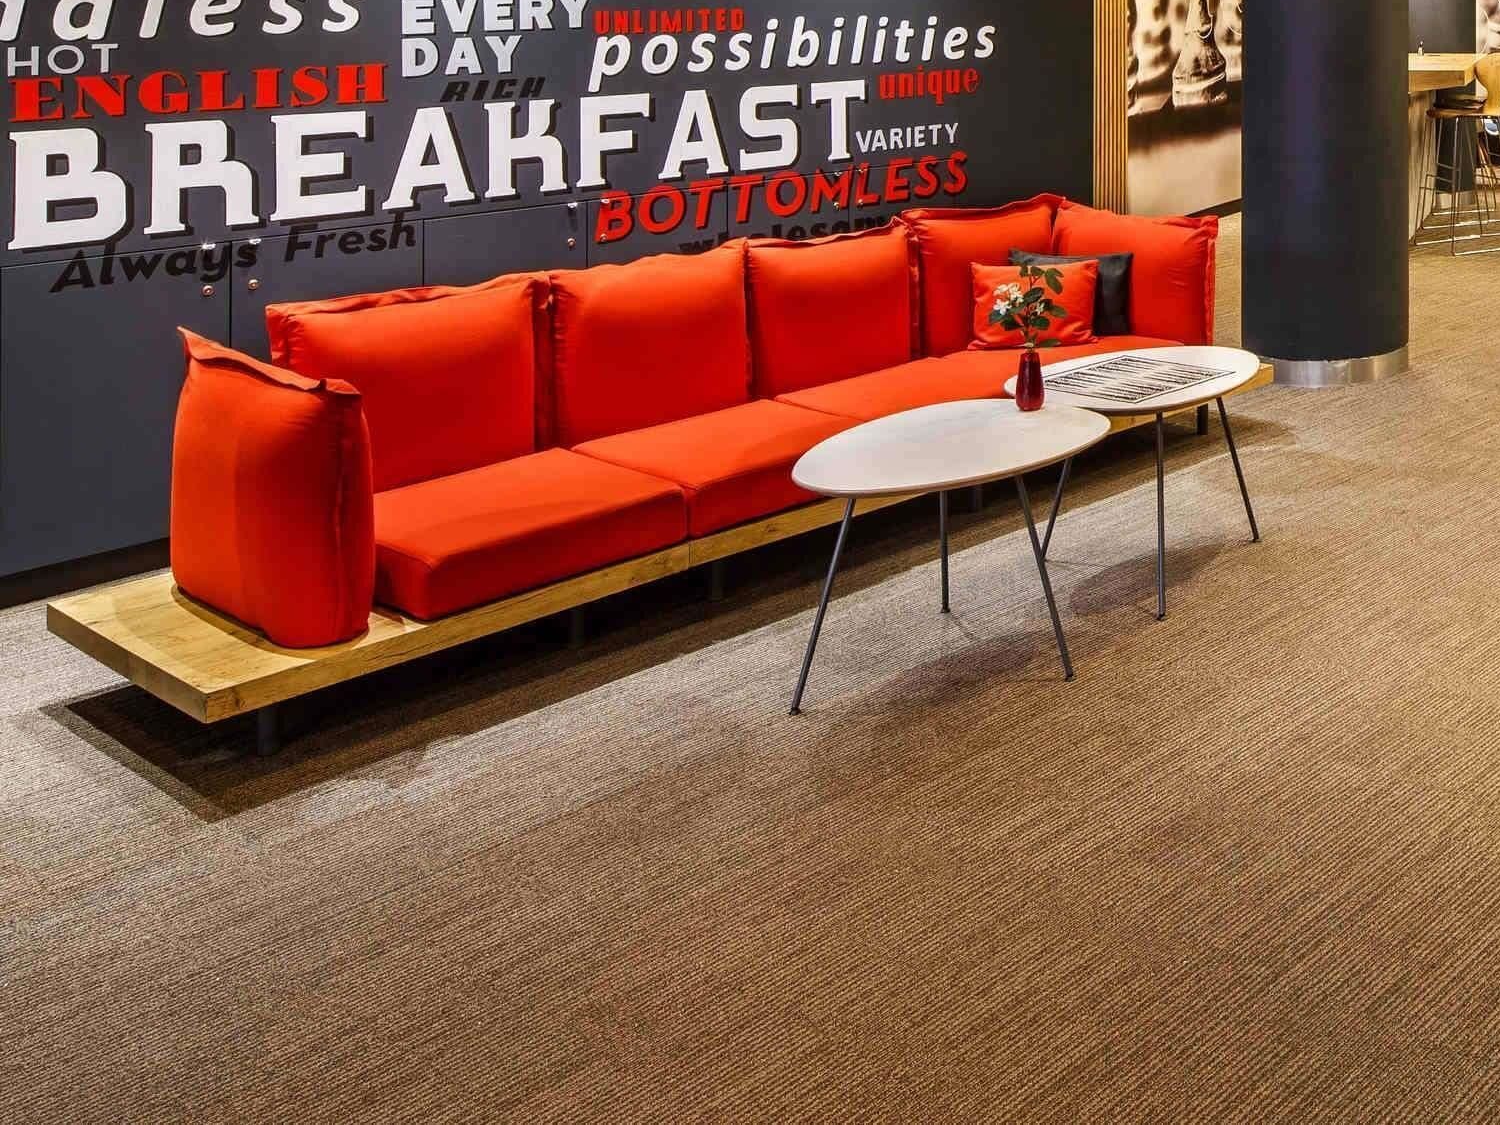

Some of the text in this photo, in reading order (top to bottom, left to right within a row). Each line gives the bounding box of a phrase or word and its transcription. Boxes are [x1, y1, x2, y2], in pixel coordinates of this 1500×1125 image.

[593, 7, 746, 36] UNLIMITED
[7, 42, 120, 76] HOT
[401, 35, 522, 78] DAY
[588, 14, 998, 93] possibilities
[8, 62, 390, 124] ENGLISH
[441, 76, 546, 103] RICH
[879, 64, 981, 106] unique
[855, 121, 960, 155] VARIETY
[7, 79, 867, 250] BREAKFAST
[593, 151, 968, 243] BOTTOMLESS
[49, 210, 418, 293] Always Fresh
